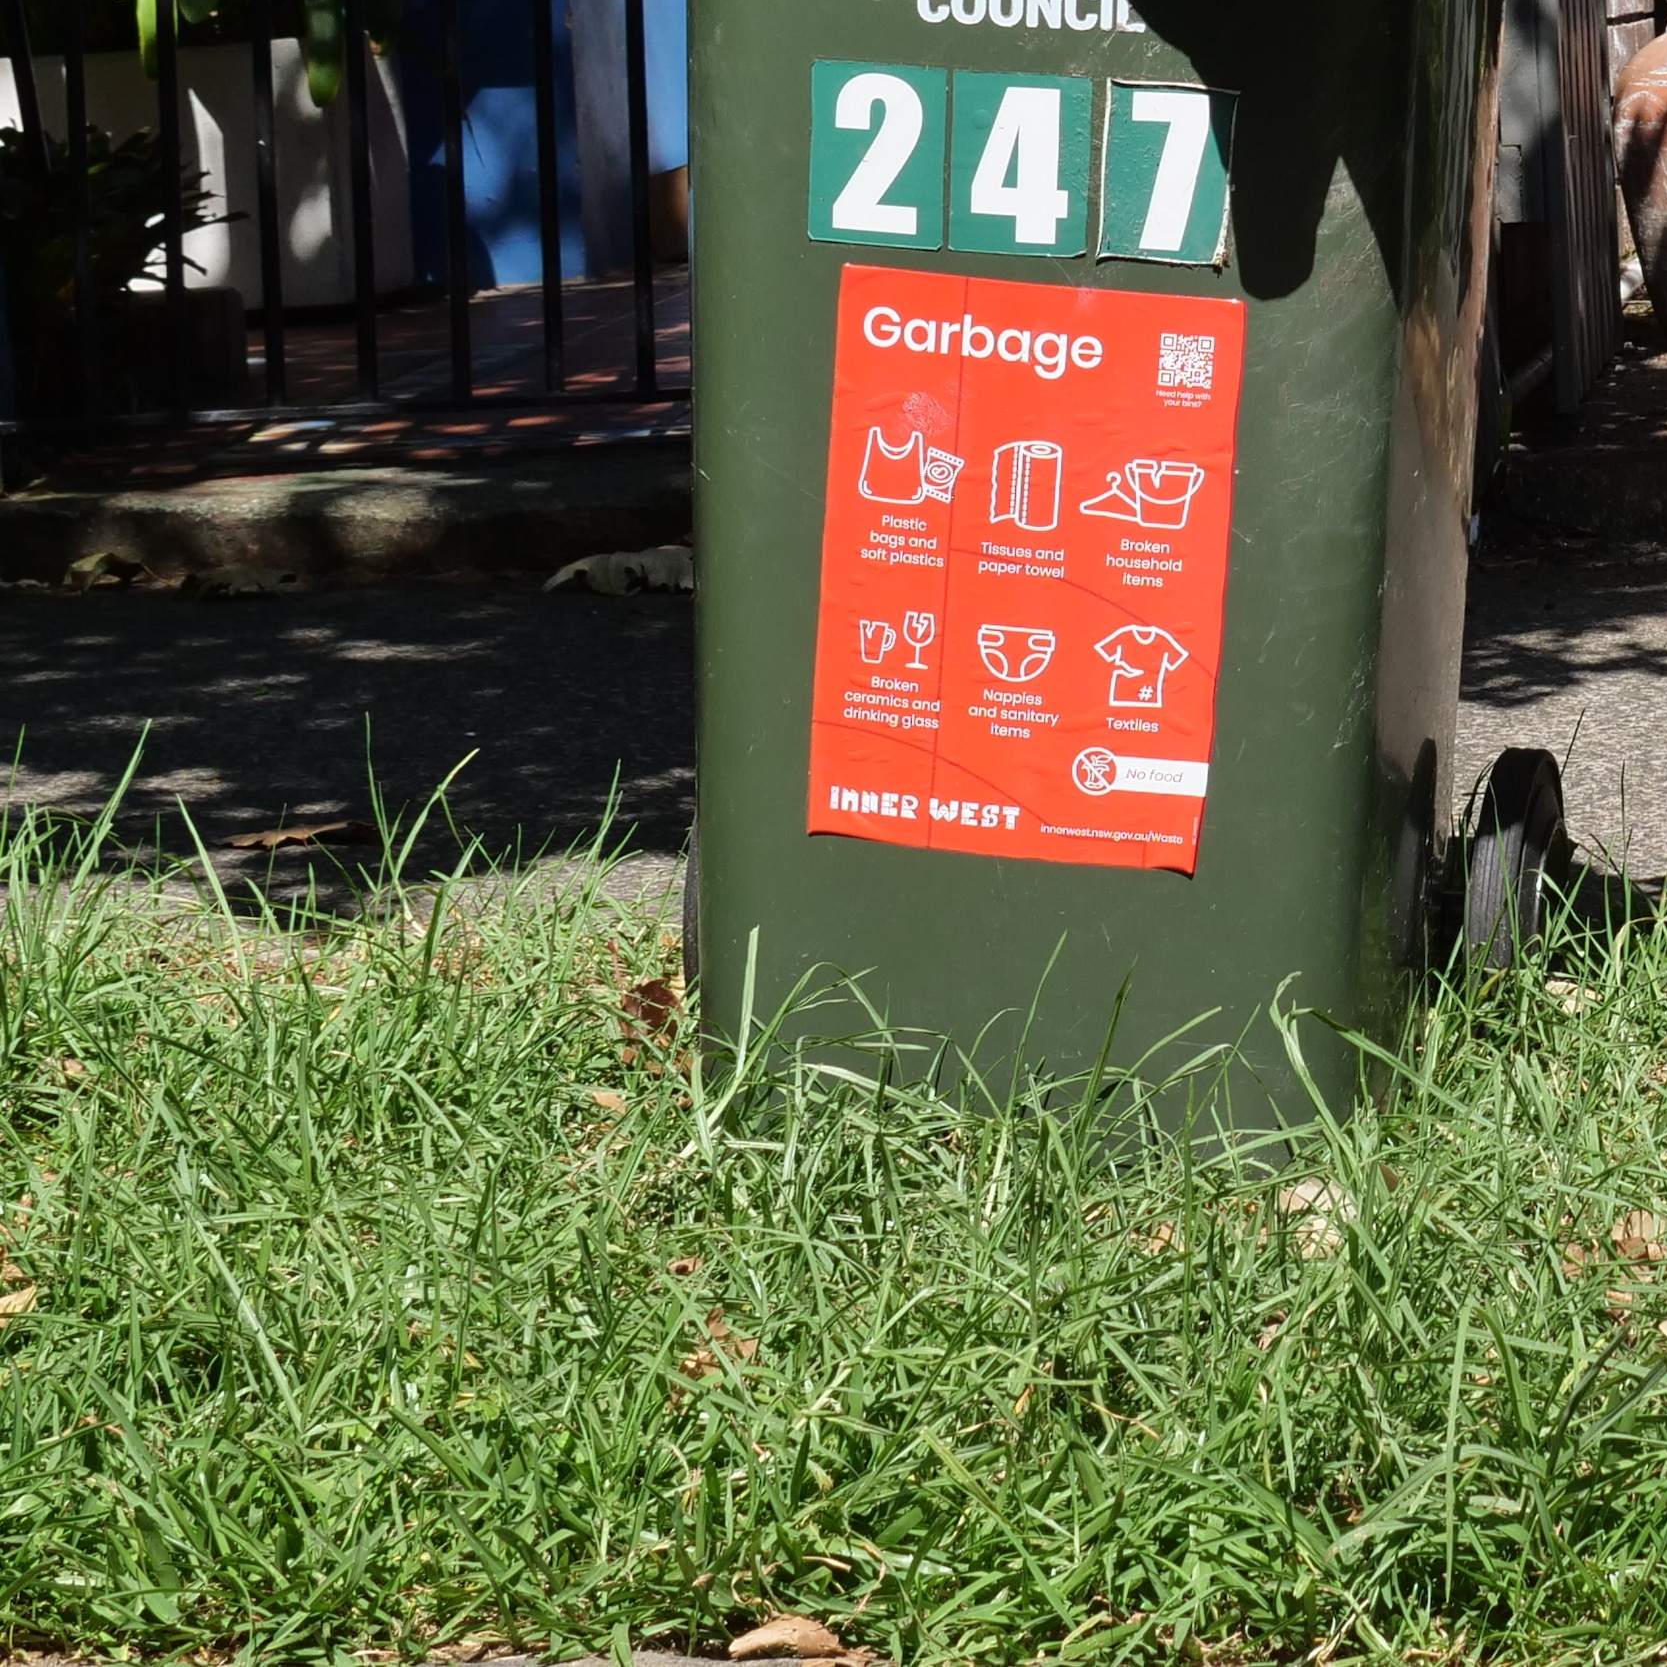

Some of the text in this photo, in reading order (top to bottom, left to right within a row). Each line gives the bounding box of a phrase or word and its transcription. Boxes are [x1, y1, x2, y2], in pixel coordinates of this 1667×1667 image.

[832, 73, 1211, 251] 247
[863, 306, 1102, 380] Garbage
[882, 515, 927, 531] Plastic
[870, 531, 937, 550] bags and
[1121, 538, 1170, 554] Broken
[861, 548, 944, 569] soft plastics
[981, 541, 1064, 561] Tissues and
[978, 561, 1065, 579] paper towel
[1106, 555, 1183, 573] household
[1123, 573, 1163, 588] items
[871, 676, 919, 693] Broken
[845, 690, 941, 712] ceramics and
[983, 689, 1042, 708] Nappies
[844, 706, 939, 730] drinking glass
[969, 704, 1059, 727] and sanitary
[1106, 716, 1158, 733] Textiles
[990, 723, 1030, 739] items
[1126, 768, 1183, 783] No food
[830, 786, 1020, 830] INNER WEST
